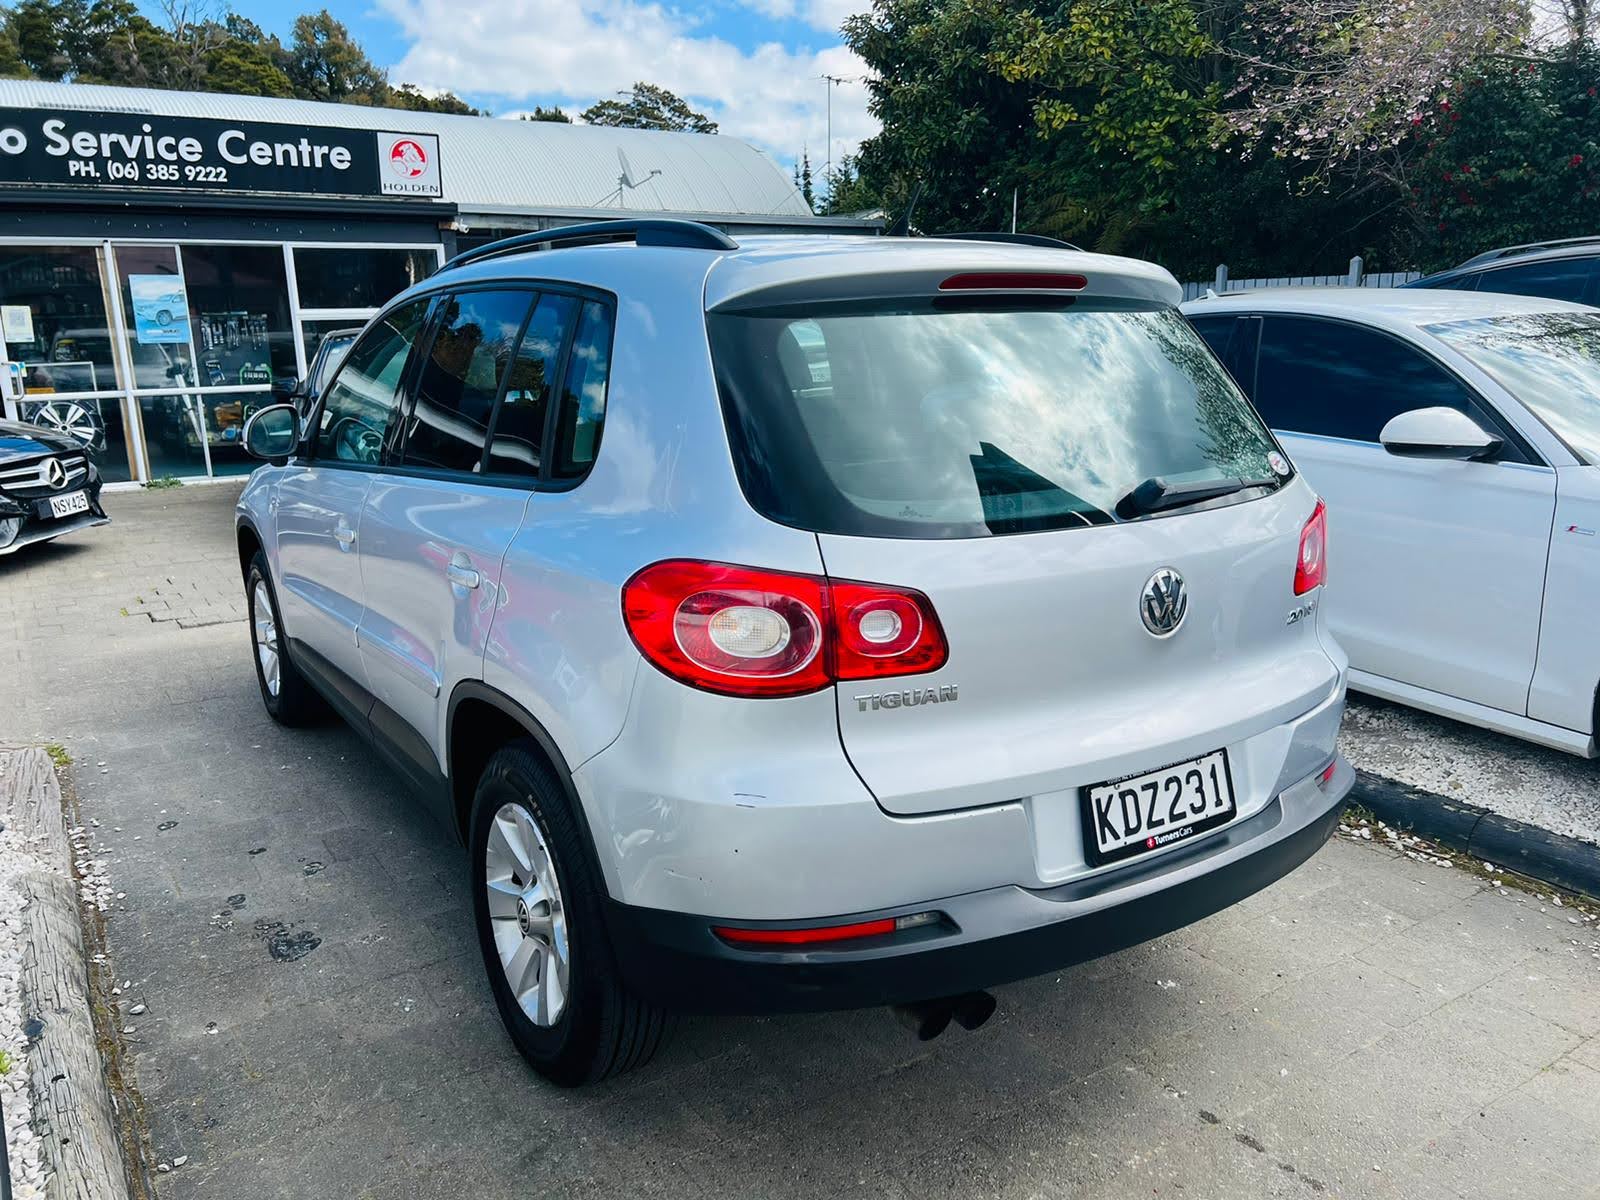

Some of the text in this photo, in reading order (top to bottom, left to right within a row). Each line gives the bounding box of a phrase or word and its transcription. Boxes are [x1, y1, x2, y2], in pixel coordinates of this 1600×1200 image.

[42, 119, 203, 162] Service
[217, 129, 352, 170] Centre
[68, 160, 228, 183] PH. (06) 385 9222
[383, 182, 439, 194] HOLDEN
[53, 494, 87, 514] NSY425
[853, 684, 959, 712] TIGUAN
[1095, 763, 1224, 846] KDZ231
